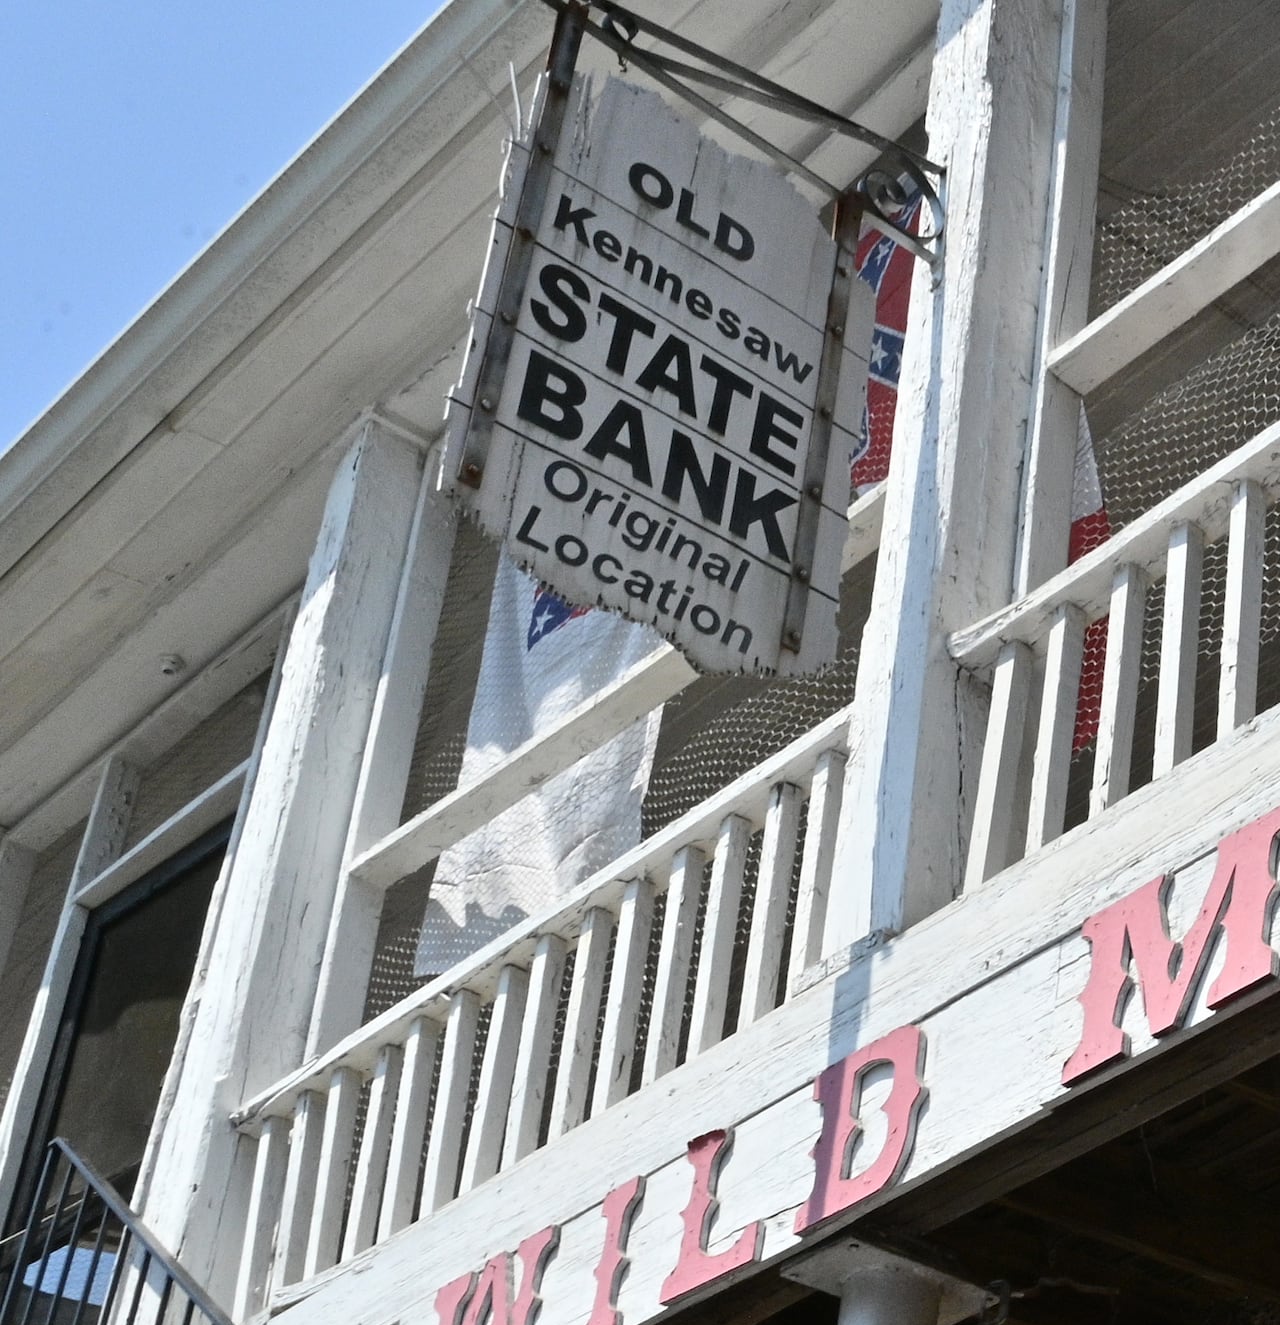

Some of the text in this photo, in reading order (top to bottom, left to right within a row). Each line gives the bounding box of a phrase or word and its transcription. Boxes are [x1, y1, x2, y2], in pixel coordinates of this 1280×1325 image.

[553, 194, 813, 384] Kennesaw
[628, 162, 755, 263] OLD
[529, 264, 805, 477] STATE
[516, 350, 799, 562] BANK
[544, 460, 750, 593] Original
[516, 505, 753, 654] Location
